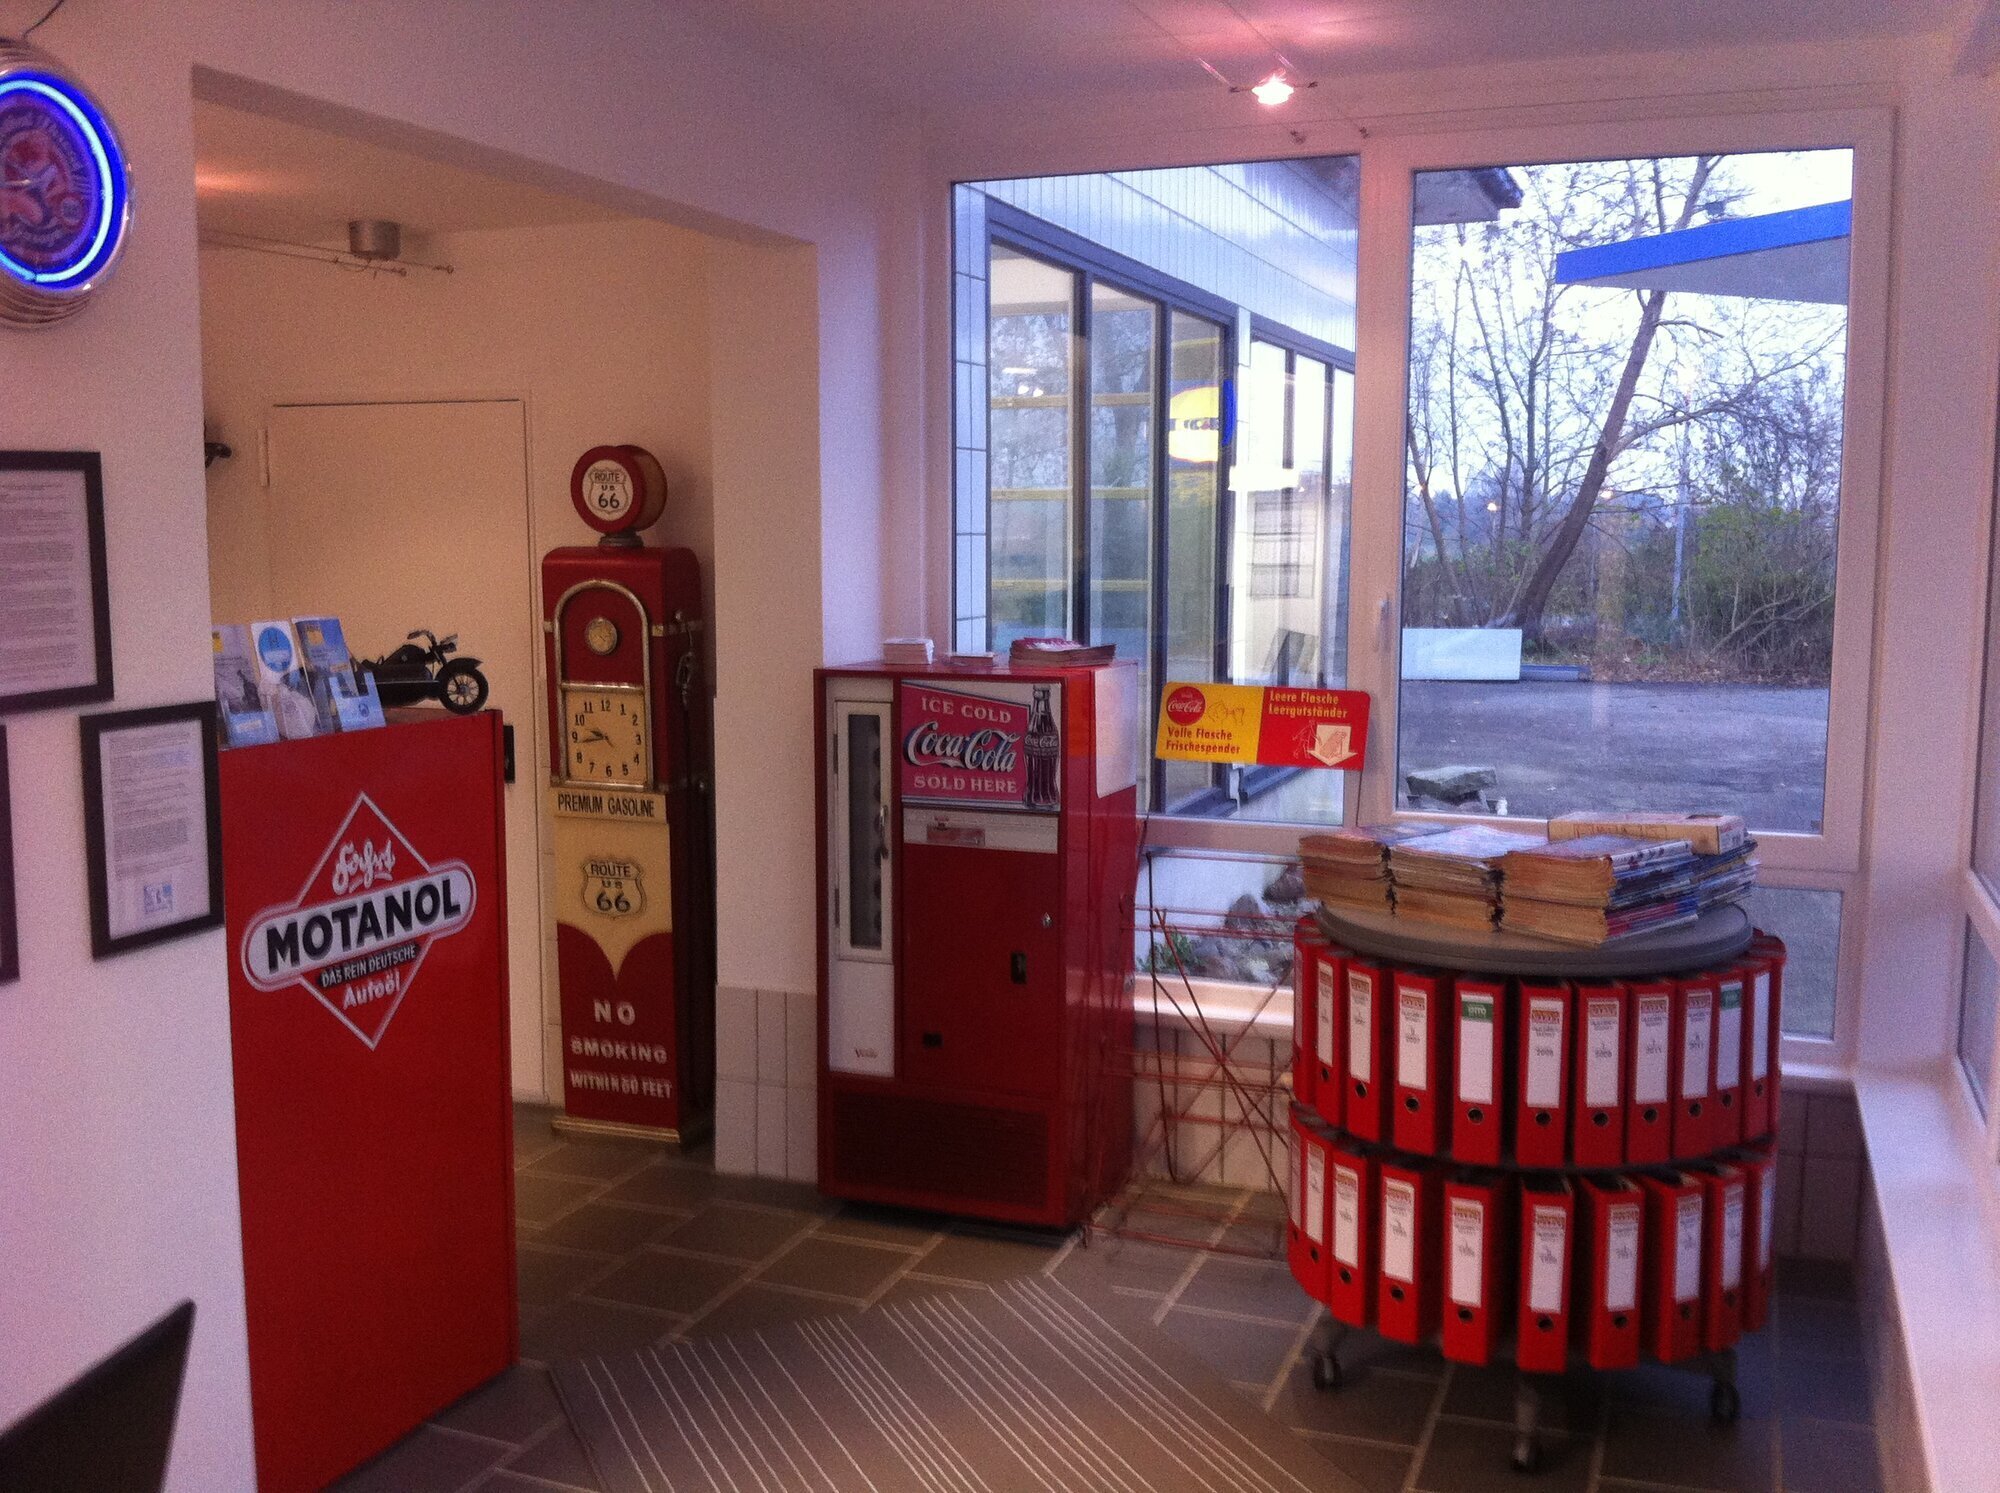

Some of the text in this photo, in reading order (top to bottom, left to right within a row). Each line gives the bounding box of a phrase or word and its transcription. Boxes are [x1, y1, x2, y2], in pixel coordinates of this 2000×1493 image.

[598, 493, 620, 509] 66
[1270, 690, 1339, 704] Leere Flasche
[584, 702, 594, 714] 11
[600, 700, 611, 712] 12
[620, 704, 626, 716] 1
[921, 697, 1011, 723] ICE COLD
[574, 714, 585, 726] 10
[632, 714, 638, 726] 2
[572, 731, 578, 743] 9
[636, 734, 642, 746] 3
[1167, 726, 1232, 740] Volle Flasche
[905, 720, 1020, 773] Coca-Cola
[1165, 740, 1240, 755] Frischespender
[576, 752, 583, 764] 8
[634, 754, 640, 766] 4
[589, 762, 595, 774] 7
[606, 765, 612, 777] 6
[622, 764, 629, 776] 5
[914, 775, 1017, 793] SOLD HERE
[558, 794, 655, 818] PREMIUM GASOLINE
[590, 862, 632, 877] ROUTE
[596, 892, 631, 913] 66
[266, 878, 461, 974] MOTANOL
[321, 944, 416, 987] DAS REIN DEUTSCHE
[343, 969, 400, 1009] Autoöl
[594, 999, 636, 1026] NO
[570, 1036, 668, 1064] SMOKING
[570, 1071, 620, 1092] WITHIN
[642, 1077, 672, 1098] FEET
